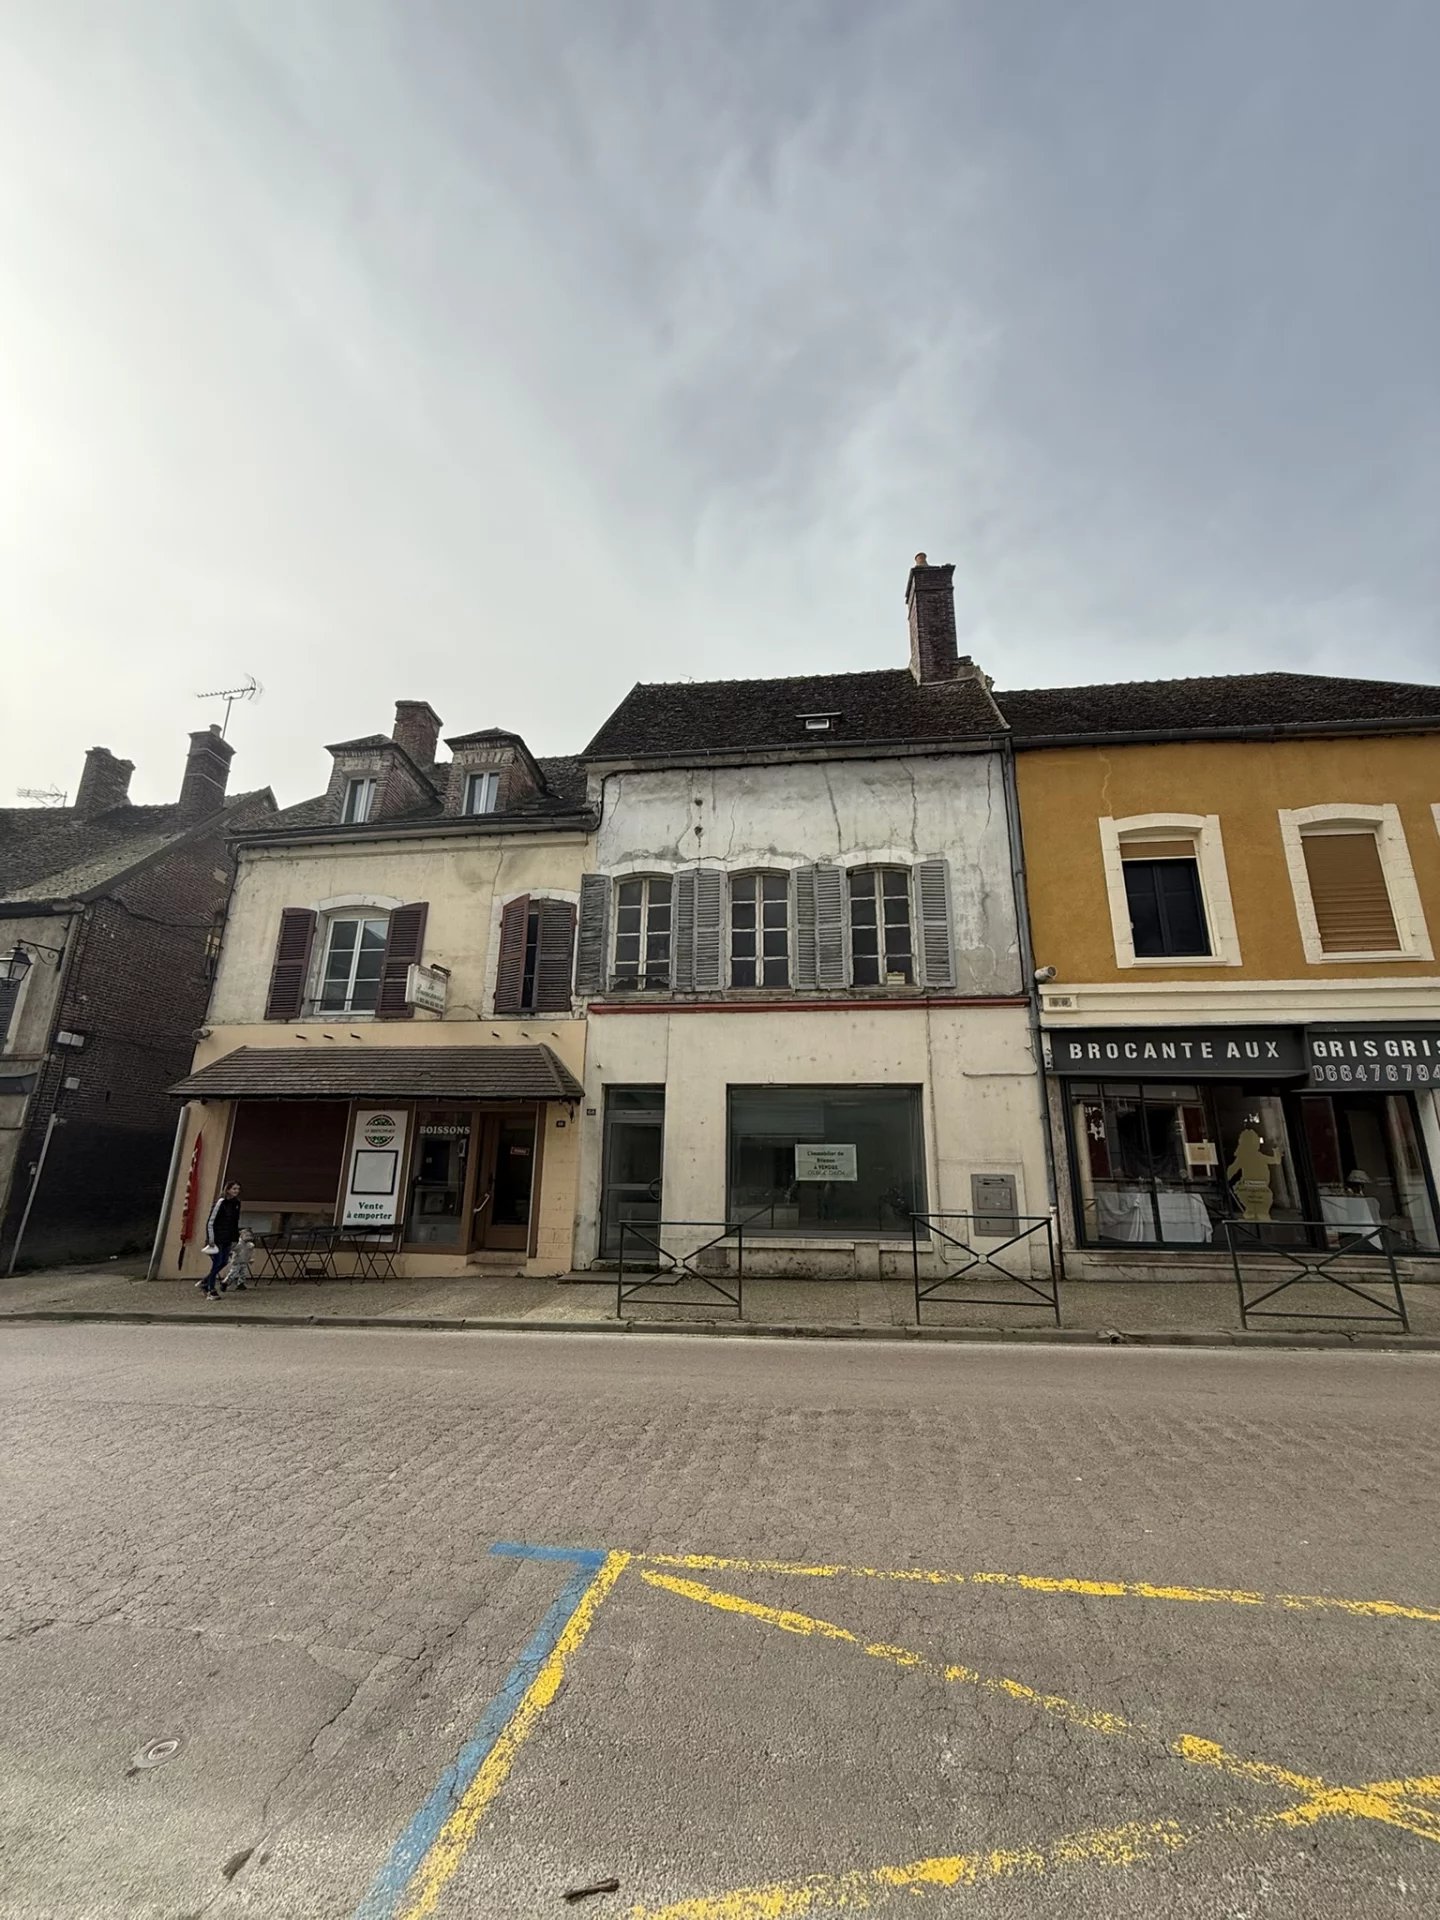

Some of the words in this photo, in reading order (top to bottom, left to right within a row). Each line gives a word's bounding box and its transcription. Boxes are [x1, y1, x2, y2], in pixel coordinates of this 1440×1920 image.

[1069, 1042, 1214, 1060] BROCANTE
[1226, 1041, 1280, 1059] AUX
[419, 1125, 471, 1135] BOISSONS
[358, 1201, 384, 1210] Vente
[346, 1210, 352, 1219] à
[353, 1212, 393, 1221] emporter
